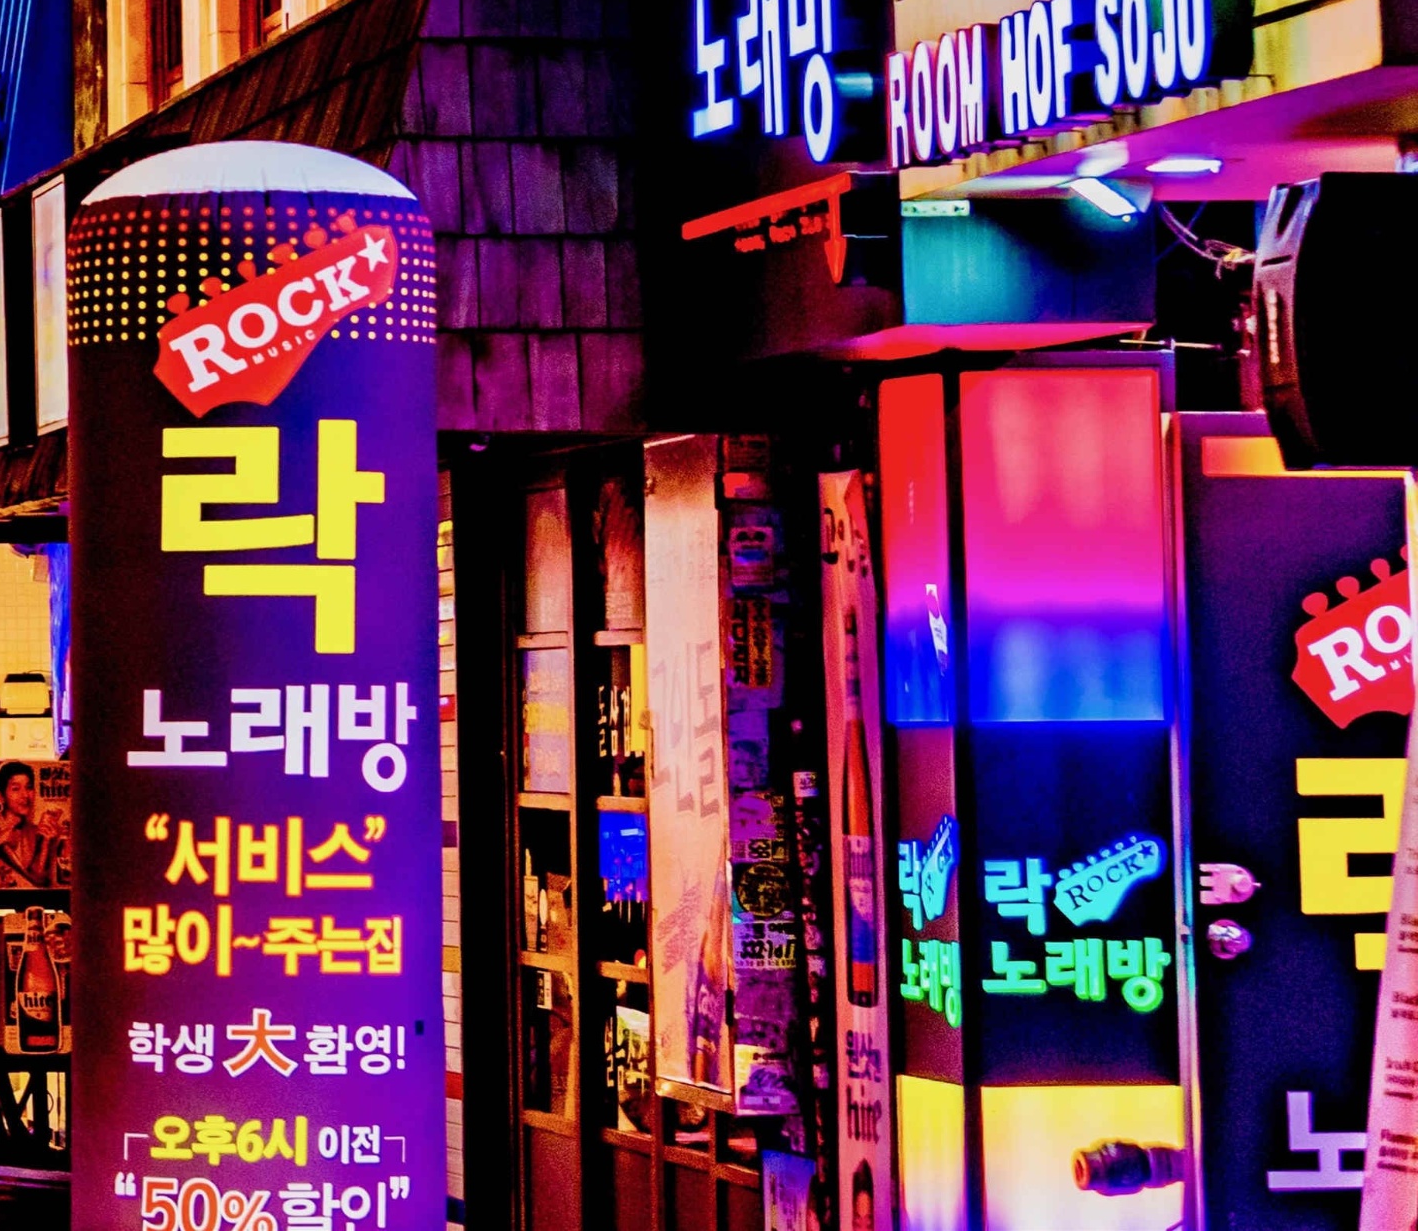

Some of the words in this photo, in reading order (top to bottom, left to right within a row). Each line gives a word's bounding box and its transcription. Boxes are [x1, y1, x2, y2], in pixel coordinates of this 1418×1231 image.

[887, 25, 985, 166] ROOM
[169, 256, 370, 392] ROCK
[251, 328, 317, 366] MUSIC
[161, 419, 385, 654] 락
[127, 683, 417, 793] 노래방
[983, 858, 1053, 935] 락
[1063, 853, 1144, 911] ROCK
[982, 938, 1171, 1013] 노래방
[128, 1021, 215, 1074] 학생
[223, 1008, 297, 1078] 大
[304, 1024, 407, 1076] 환영!
[150, 1114, 308, 1167] 오후6시
[318, 1125, 381, 1165] 이전
